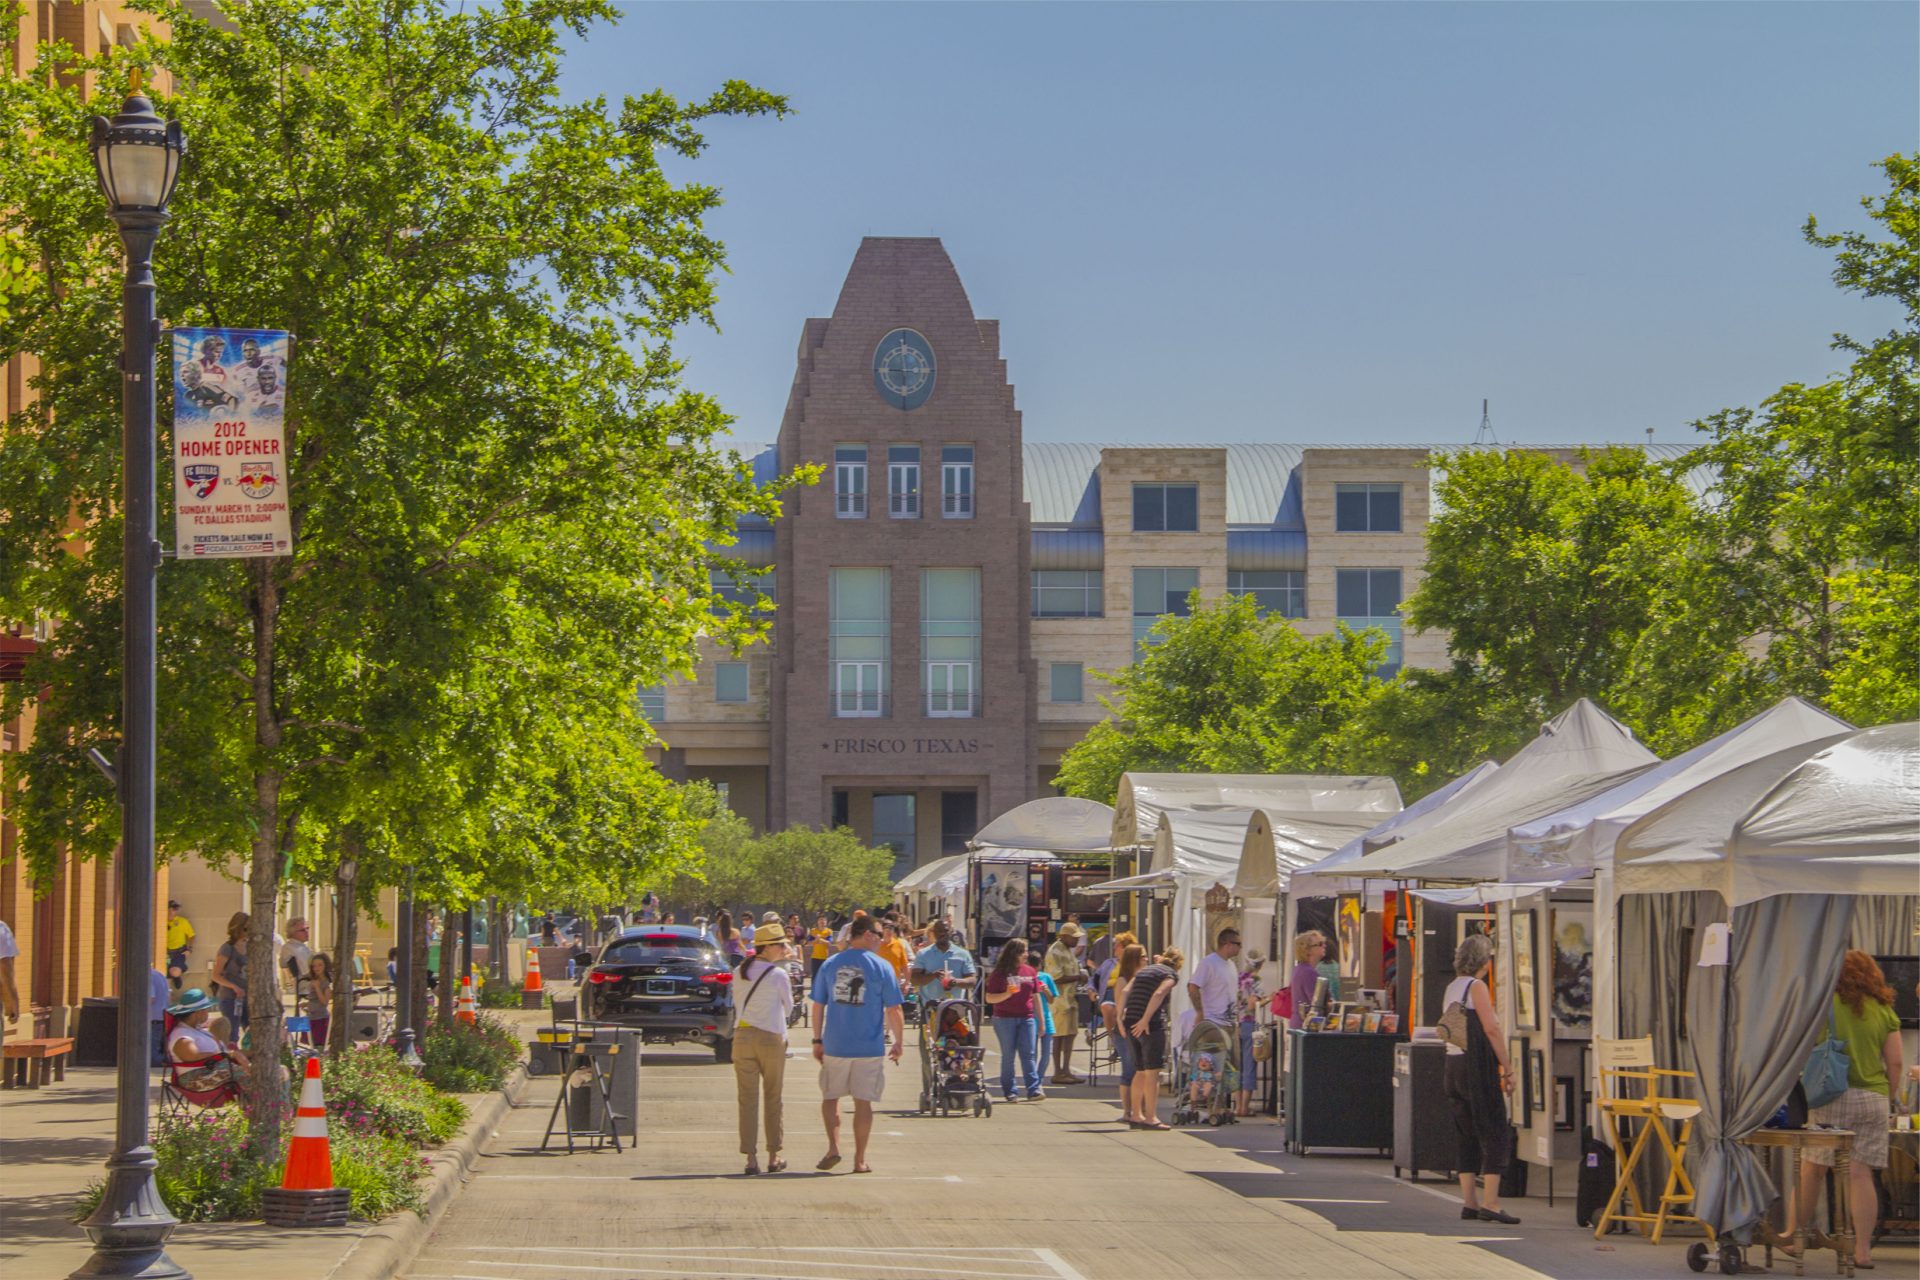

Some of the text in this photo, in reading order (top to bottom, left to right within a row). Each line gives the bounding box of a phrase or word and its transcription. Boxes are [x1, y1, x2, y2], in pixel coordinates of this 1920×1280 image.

[214, 422, 246, 437] 2012
[181, 439, 280, 456] HOME OPENER
[185, 467, 194, 475] FC
[216, 504, 242, 513] MARCH
[194, 514, 272, 525] FC DALLAS STADIUM
[194, 535, 219, 543] TICKETS
[247, 533, 262, 541] NOW
[834, 738, 979, 754] FRISCO TEXAS
